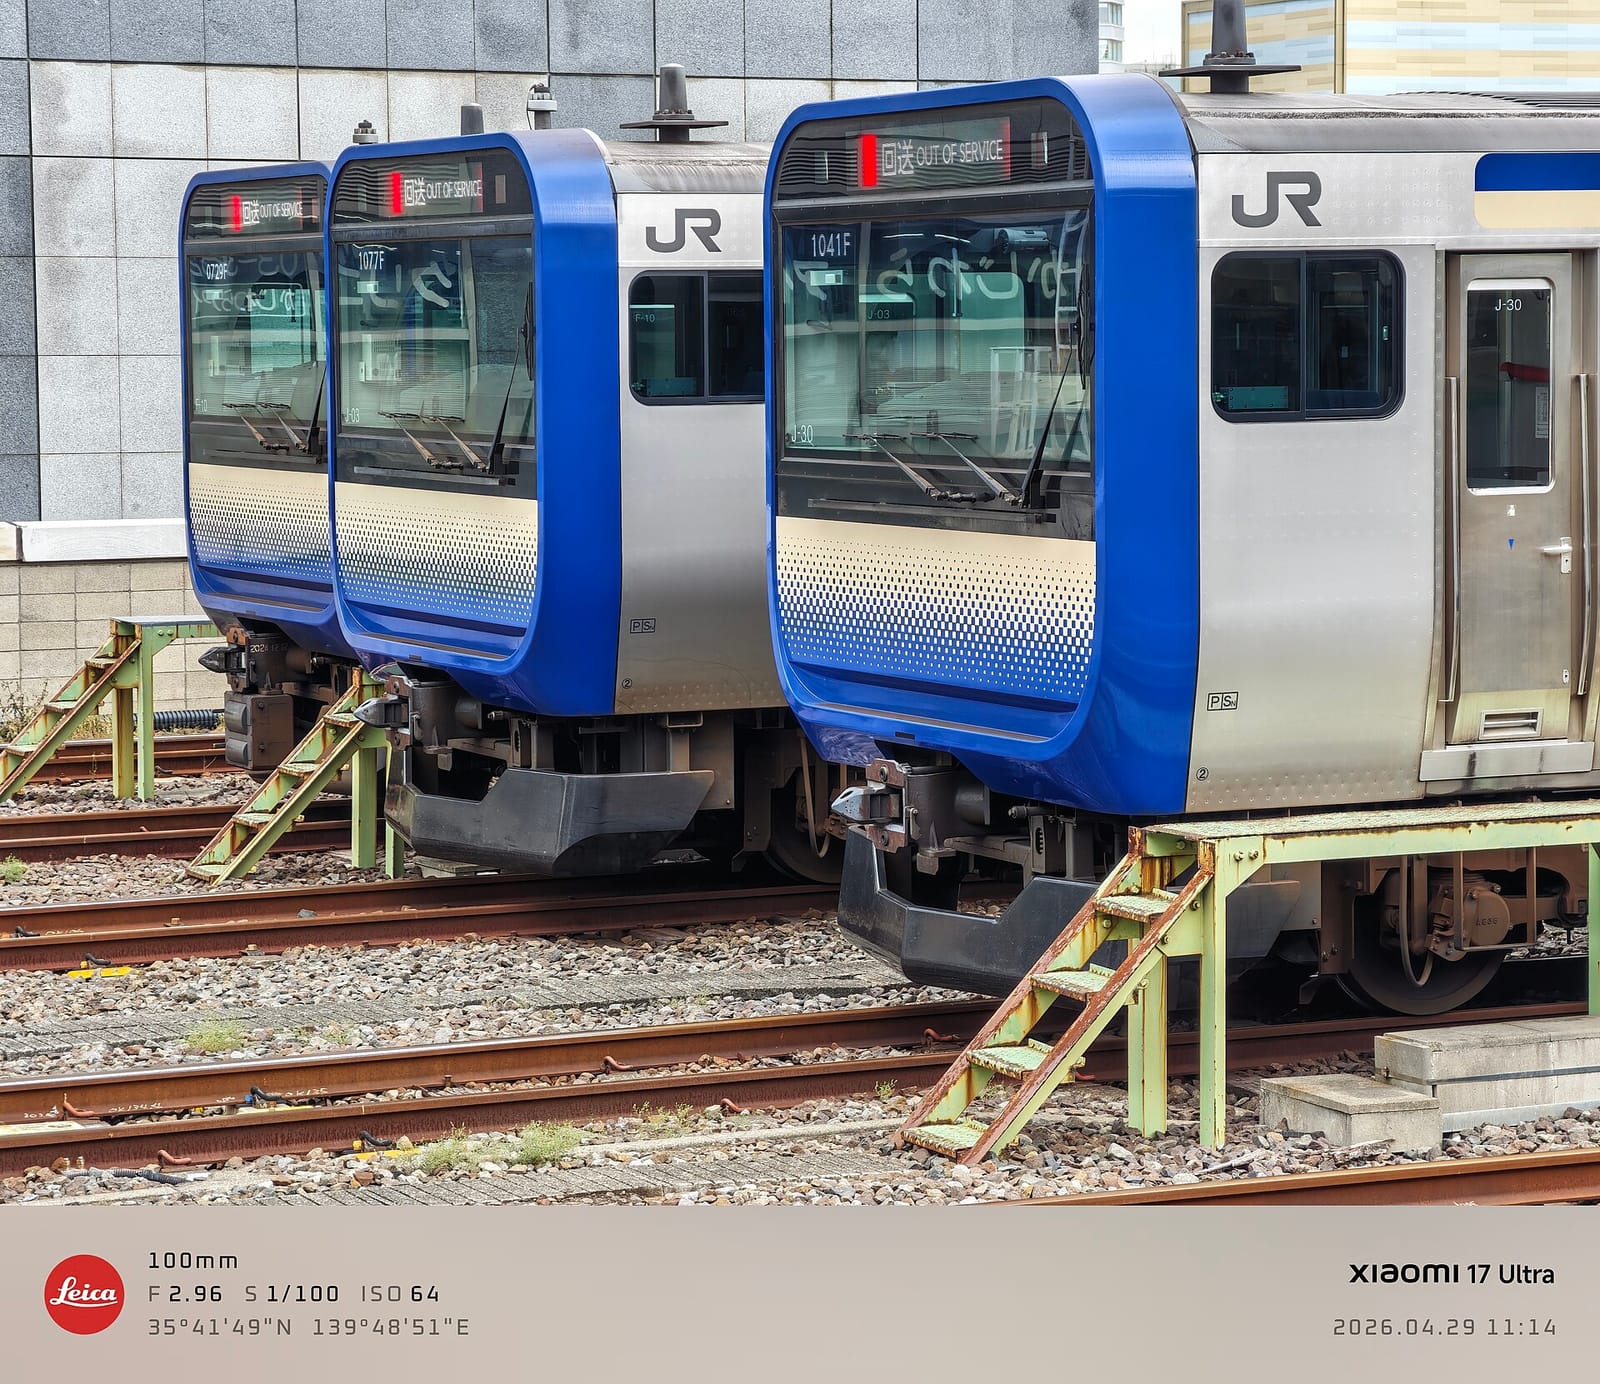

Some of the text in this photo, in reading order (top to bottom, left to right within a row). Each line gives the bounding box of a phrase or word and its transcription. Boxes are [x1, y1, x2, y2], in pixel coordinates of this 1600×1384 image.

[882, 139, 1004, 176] 回送 OUT OF SERVICE
[404, 177, 482, 206] 回送 OUT OF SERVICE
[1232, 171, 1322, 228] JR
[242, 200, 304, 225] 回送 OUT OF SERVICE
[645, 208, 722, 253] JR
[811, 232, 851, 257] 1041F
[358, 250, 385, 271] 1077F
[206, 263, 228, 280] 0729F
[867, 309, 890, 319] J-03
[1494, 298, 1522, 311] J-30
[635, 313, 656, 323] F-10
[344, 407, 360, 423] J-03
[791, 424, 814, 443] J-30
